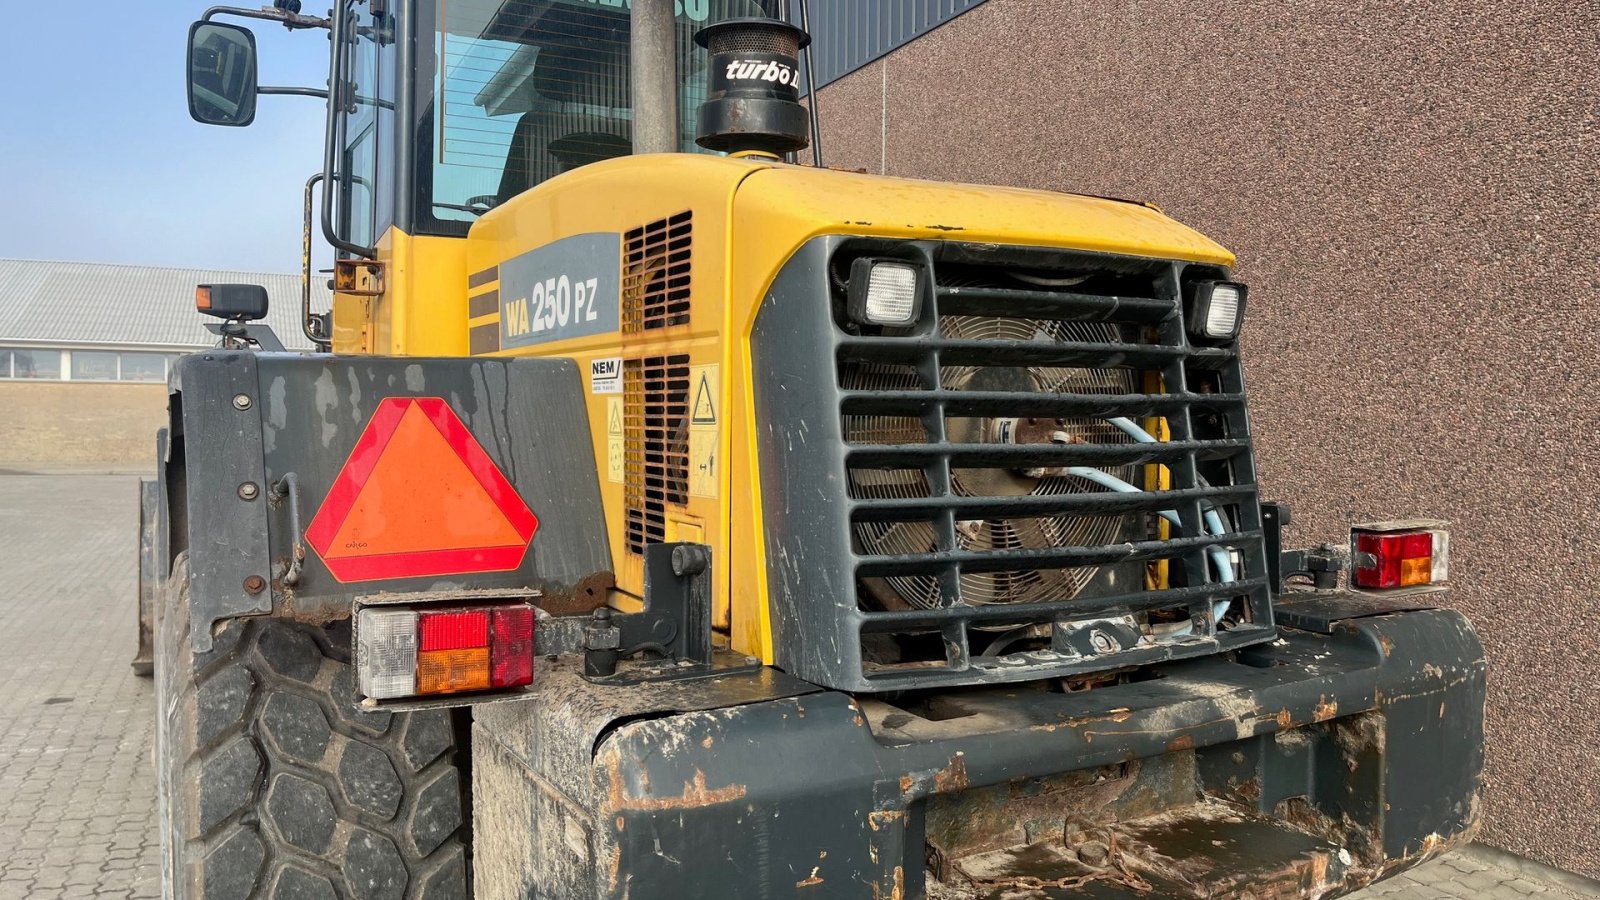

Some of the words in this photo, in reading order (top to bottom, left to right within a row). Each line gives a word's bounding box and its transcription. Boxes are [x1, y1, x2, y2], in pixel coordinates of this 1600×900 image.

[726, 60, 790, 84] turbo
[505, 298, 530, 336] WA
[532, 274, 571, 332] 250
[575, 277, 598, 323] PZ
[592, 361, 614, 375] NEM
